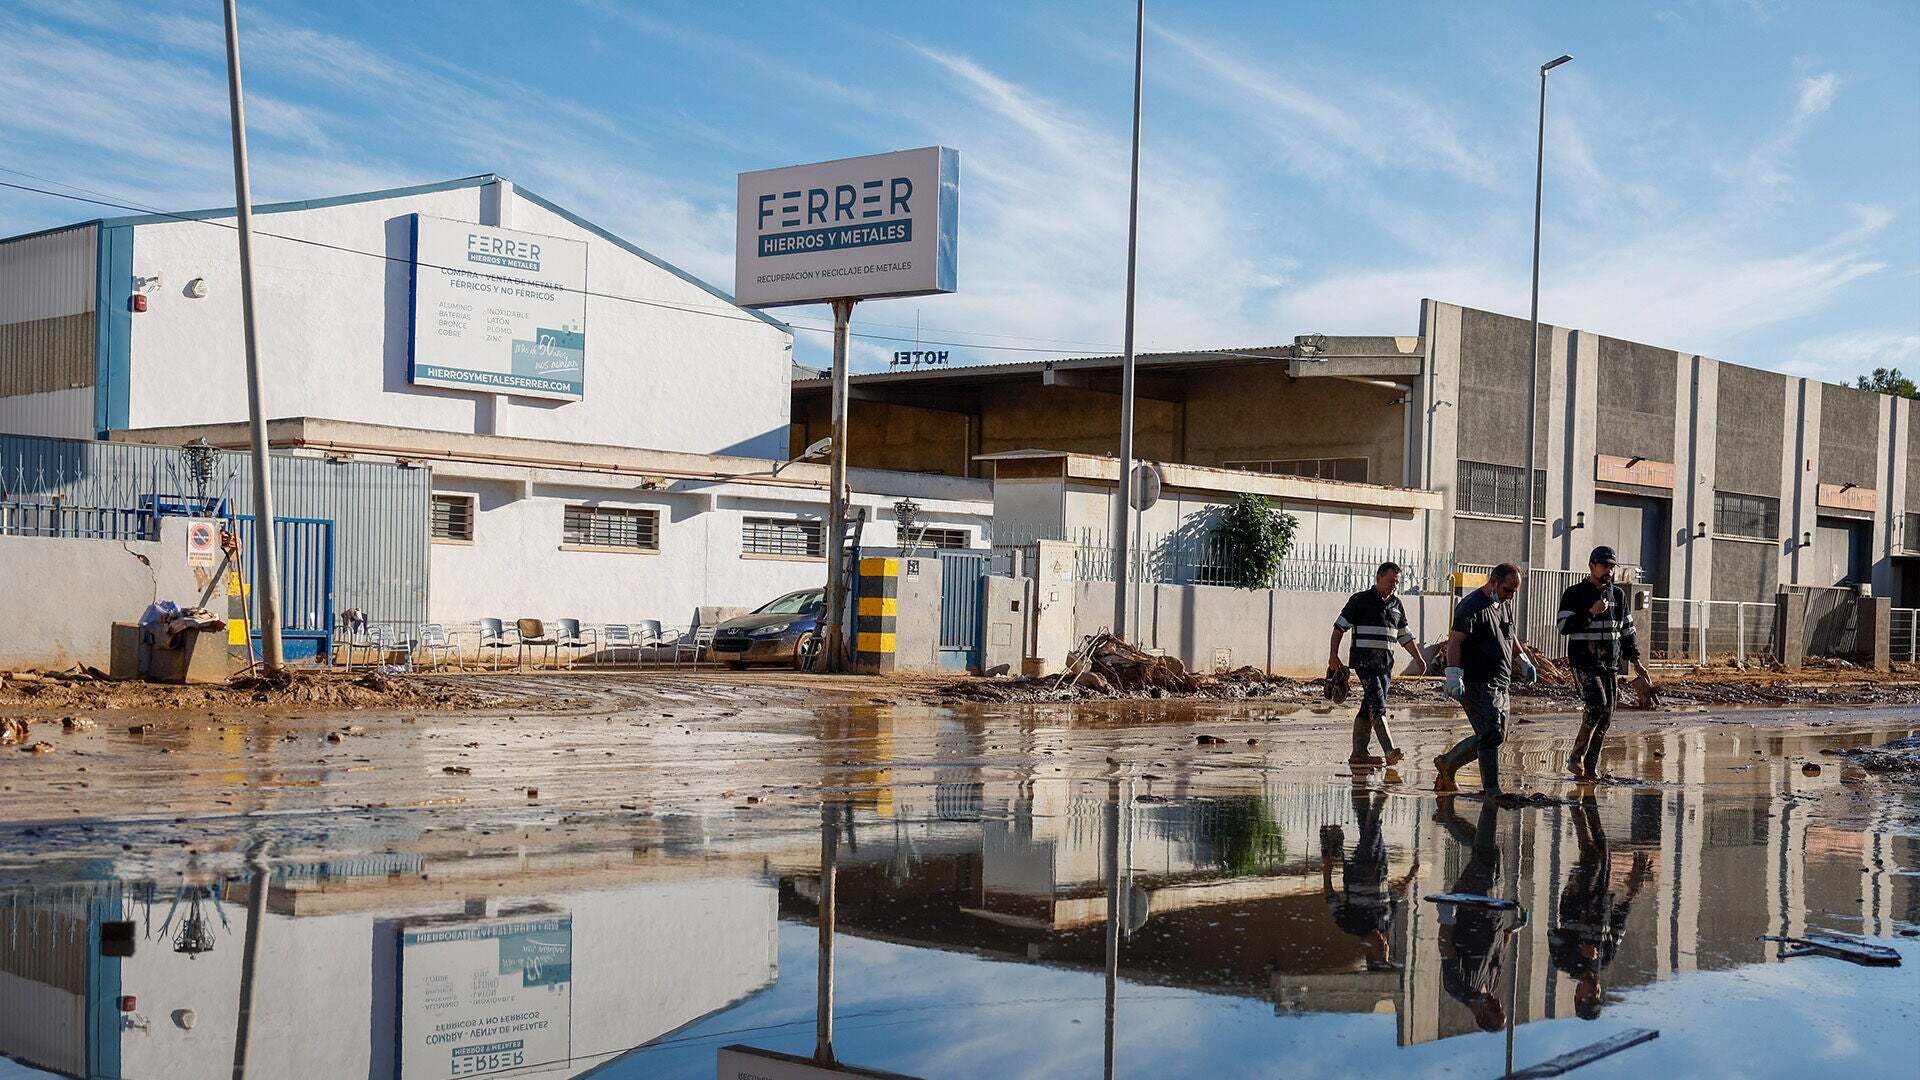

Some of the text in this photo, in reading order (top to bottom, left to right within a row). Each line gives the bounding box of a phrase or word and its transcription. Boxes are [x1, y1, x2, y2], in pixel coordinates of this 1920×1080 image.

[758, 177, 913, 230] FERRER
[468, 234, 540, 260] FERRER
[764, 225, 905, 253] HIERROS Y METALES
[470, 254, 501, 265] HIERROS
[508, 260, 538, 270] METALES
[815, 270, 821, 278] Y
[822, 266, 862, 278] RECICLAJE
[864, 264, 875, 274] DE
[876, 262, 912, 272] METALES
[441, 267, 479, 279] COMPRA
[486, 272, 513, 284] VENTA
[515, 276, 526, 286] DE
[529, 279, 564, 292] METALES
[500, 286, 514, 296] NO
[438, 301, 473, 312] ALUMINIO
[488, 308, 529, 320] INOXIDABLE
[438, 320, 467, 330] BRONCE
[438, 328, 462, 338] COBRE
[486, 326, 512, 335] PLOMO
[486, 334, 504, 344] ZINC
[540, 334, 556, 358] 50
[428, 368, 571, 392] HIERROSYMETALESFERRER.COM
